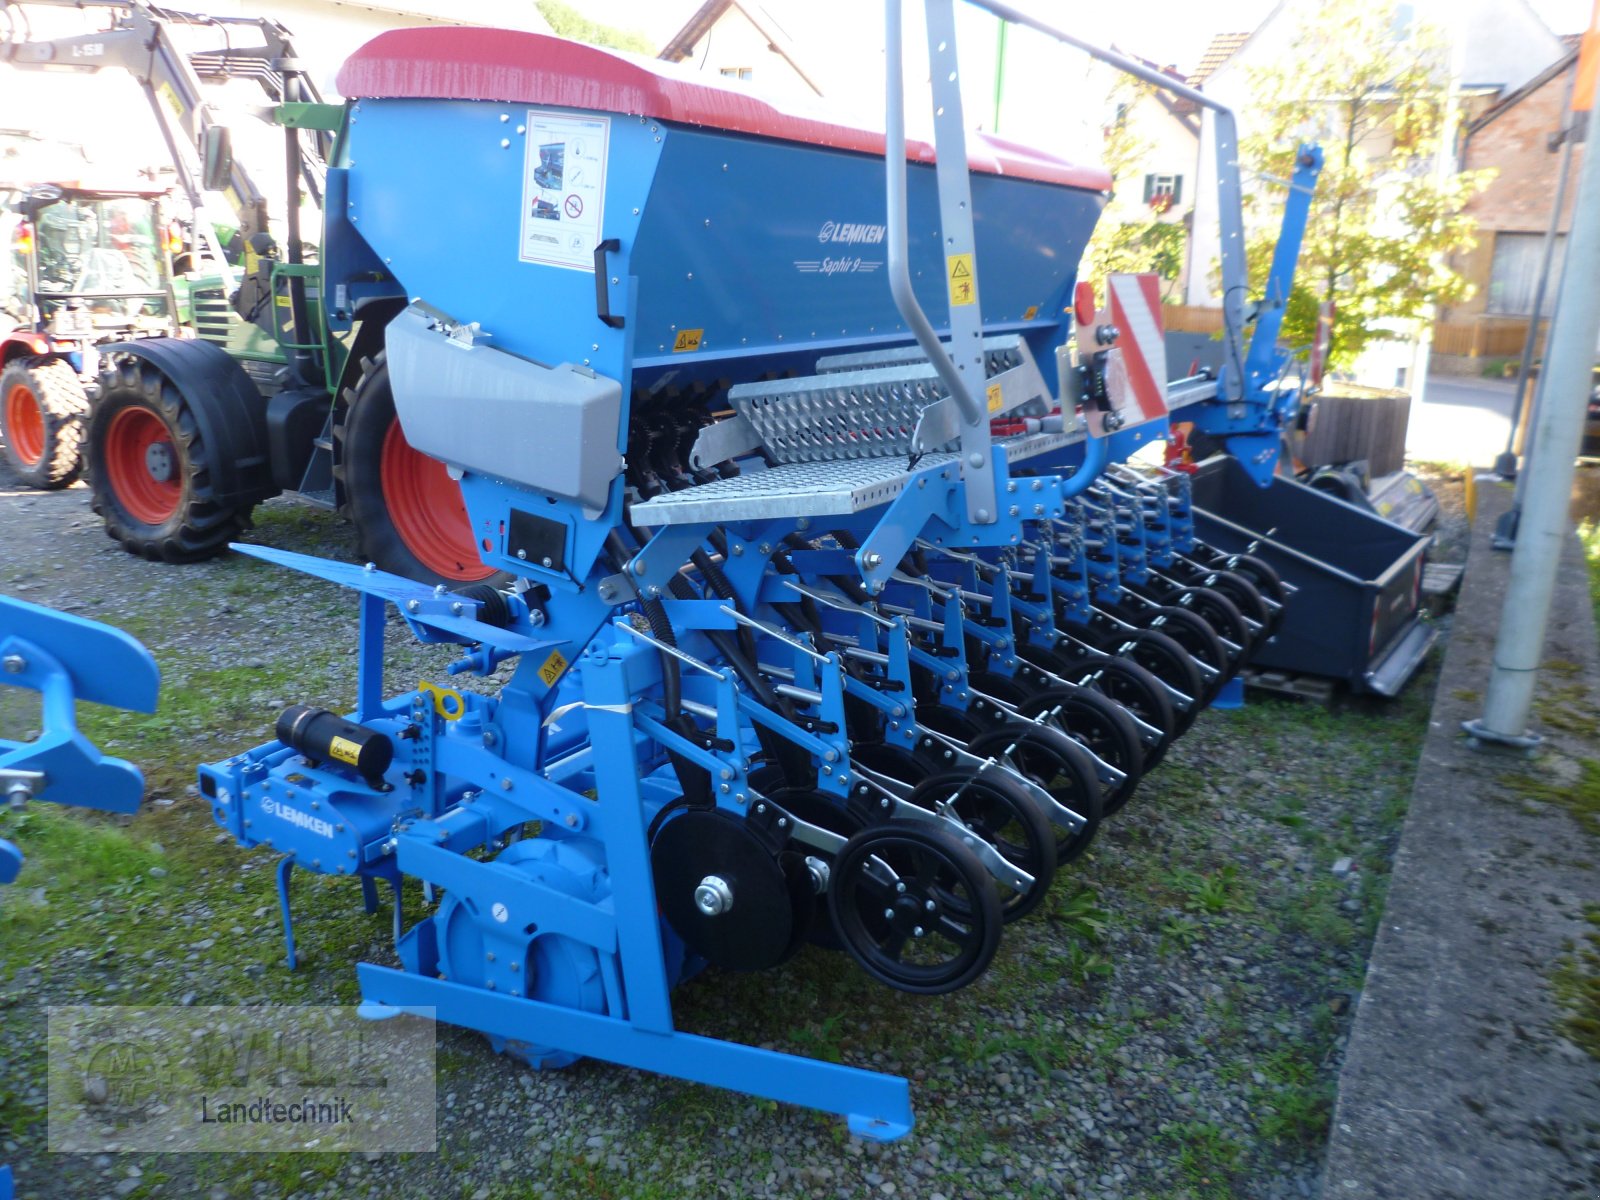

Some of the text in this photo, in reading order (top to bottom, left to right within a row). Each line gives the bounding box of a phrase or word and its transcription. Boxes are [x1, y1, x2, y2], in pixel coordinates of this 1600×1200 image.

[831, 223, 886, 245] LEMKEN
[819, 256, 861, 276] Saphir 9
[274, 801, 334, 839] LEMKEN
